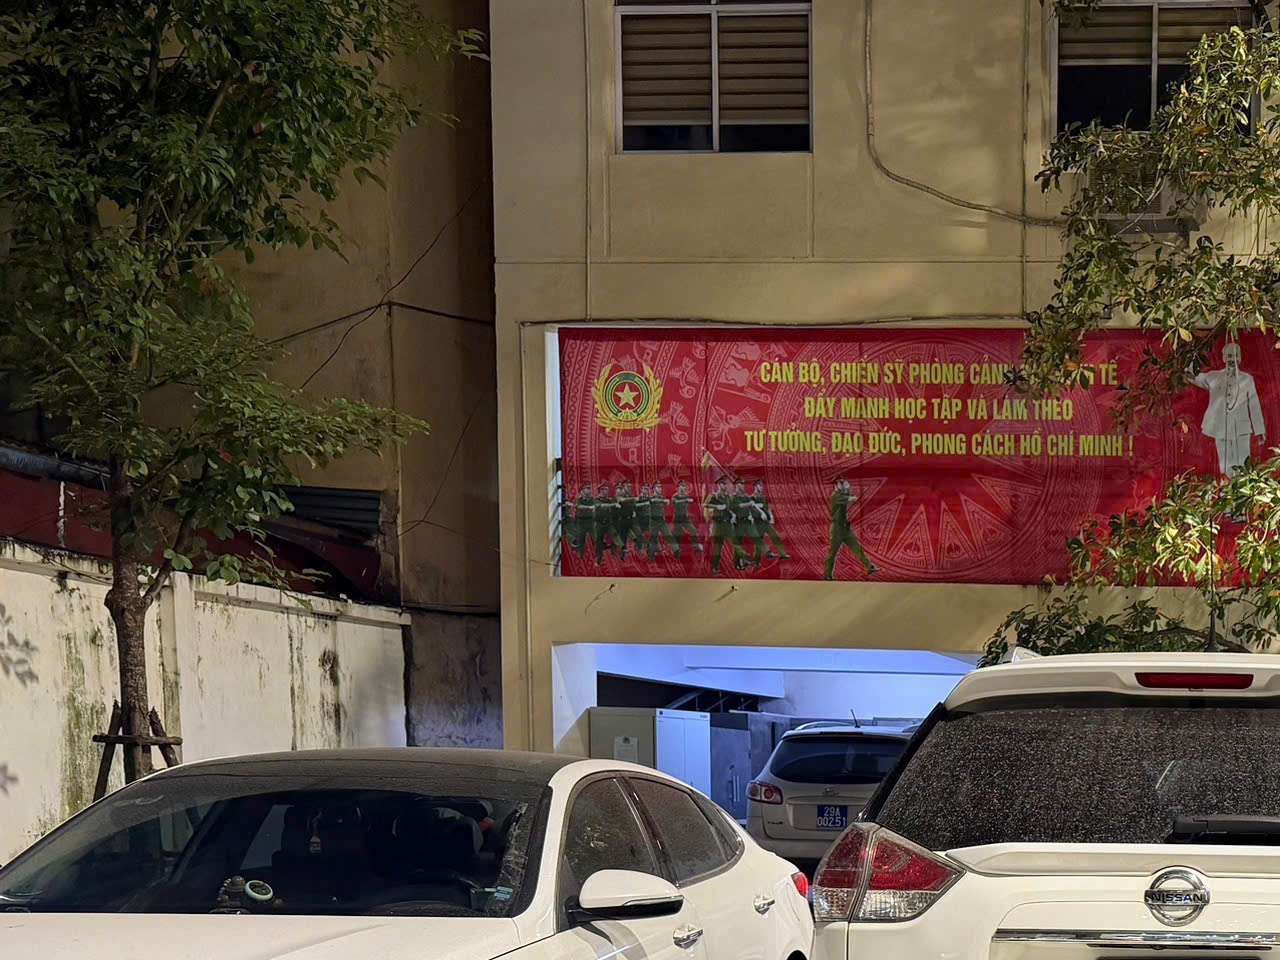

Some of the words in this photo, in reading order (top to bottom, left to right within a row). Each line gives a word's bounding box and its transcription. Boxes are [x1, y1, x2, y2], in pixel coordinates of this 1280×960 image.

[760, 357, 794, 384] CÁN
[798, 358, 826, 388] BỘ,
[830, 355, 879, 384] CHIẾN
[909, 357, 965, 385] PHÒNG
[969, 354, 1009, 385] CẢN
[1100, 356, 1119, 385] TẾ
[895, 398, 927, 424] HỌC
[932, 394, 962, 424] TẬP
[967, 394, 988, 420] VÀ
[1032, 399, 1073, 421] THEO
[744, 429, 766, 451] TƯ
[831, 432, 864, 457] ĐẠO
[868, 427, 906, 457] ĐỨC,
[911, 433, 967, 455] PHONG
[971, 430, 1015, 456] CÁCH
[1020, 427, 1042, 456] HỒ
[1047, 430, 1074, 456] CHÍ
[1079, 434, 1123, 457] MINH
[824, 806, 841, 817] 29A
[1151, 893, 1203, 902] NISSAN
